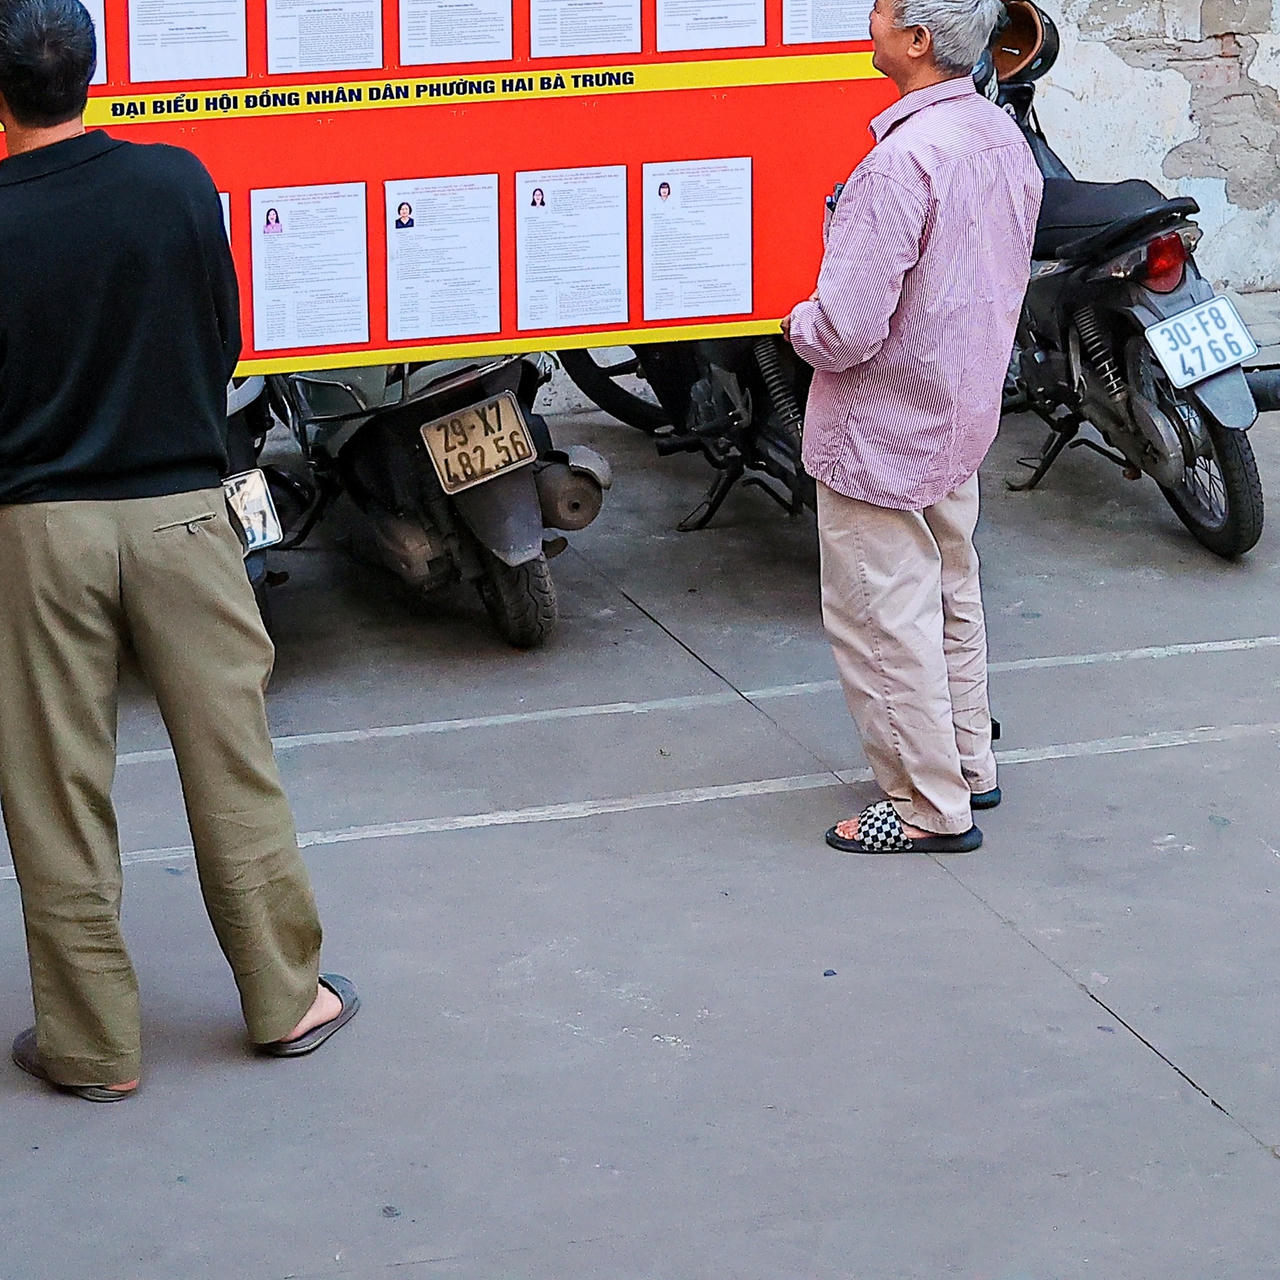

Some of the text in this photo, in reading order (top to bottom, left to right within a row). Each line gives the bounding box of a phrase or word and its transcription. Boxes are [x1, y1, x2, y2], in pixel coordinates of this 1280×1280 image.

[111, 71, 634, 119] ĐẠI BIỂU HỘI ĐỒNG NHÂN DÂN PHƯỜNG HAI BÀ TRƯNG
[1160, 307, 1227, 351] 30-F8
[1180, 333, 1242, 377] 4766
[436, 401, 502, 453] 29-X7
